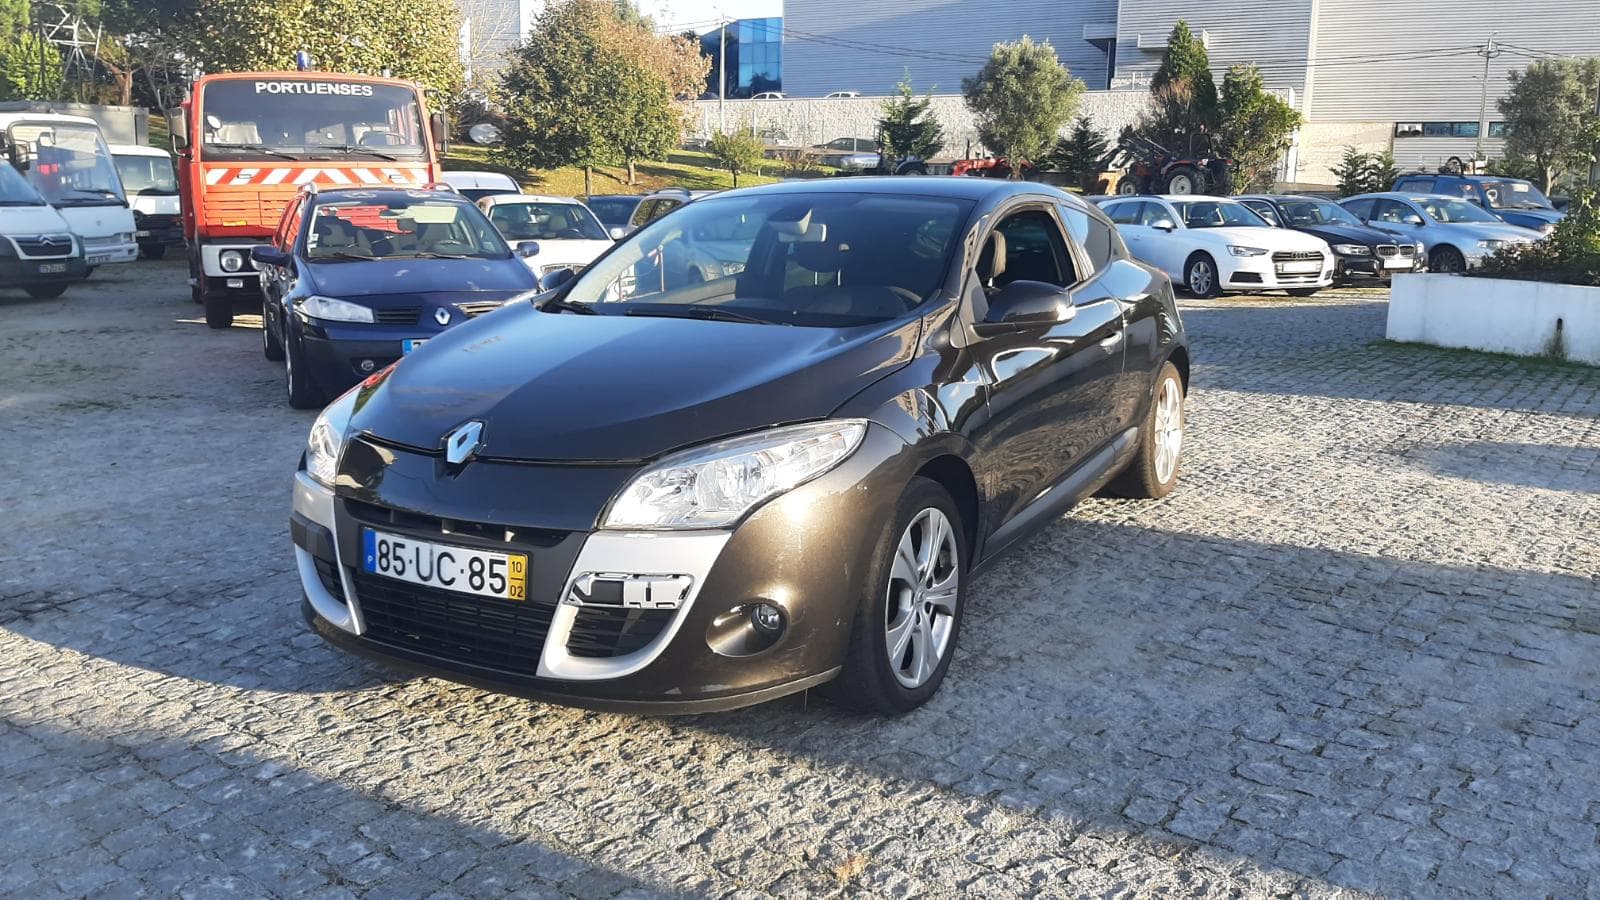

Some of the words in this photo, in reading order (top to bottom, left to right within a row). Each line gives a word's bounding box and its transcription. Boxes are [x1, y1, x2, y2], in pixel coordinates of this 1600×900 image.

[255, 82, 373, 97] PORTUENSES
[367, 555, 373, 564] P
[511, 561, 522, 574] 10
[510, 586, 524, 598] 02
